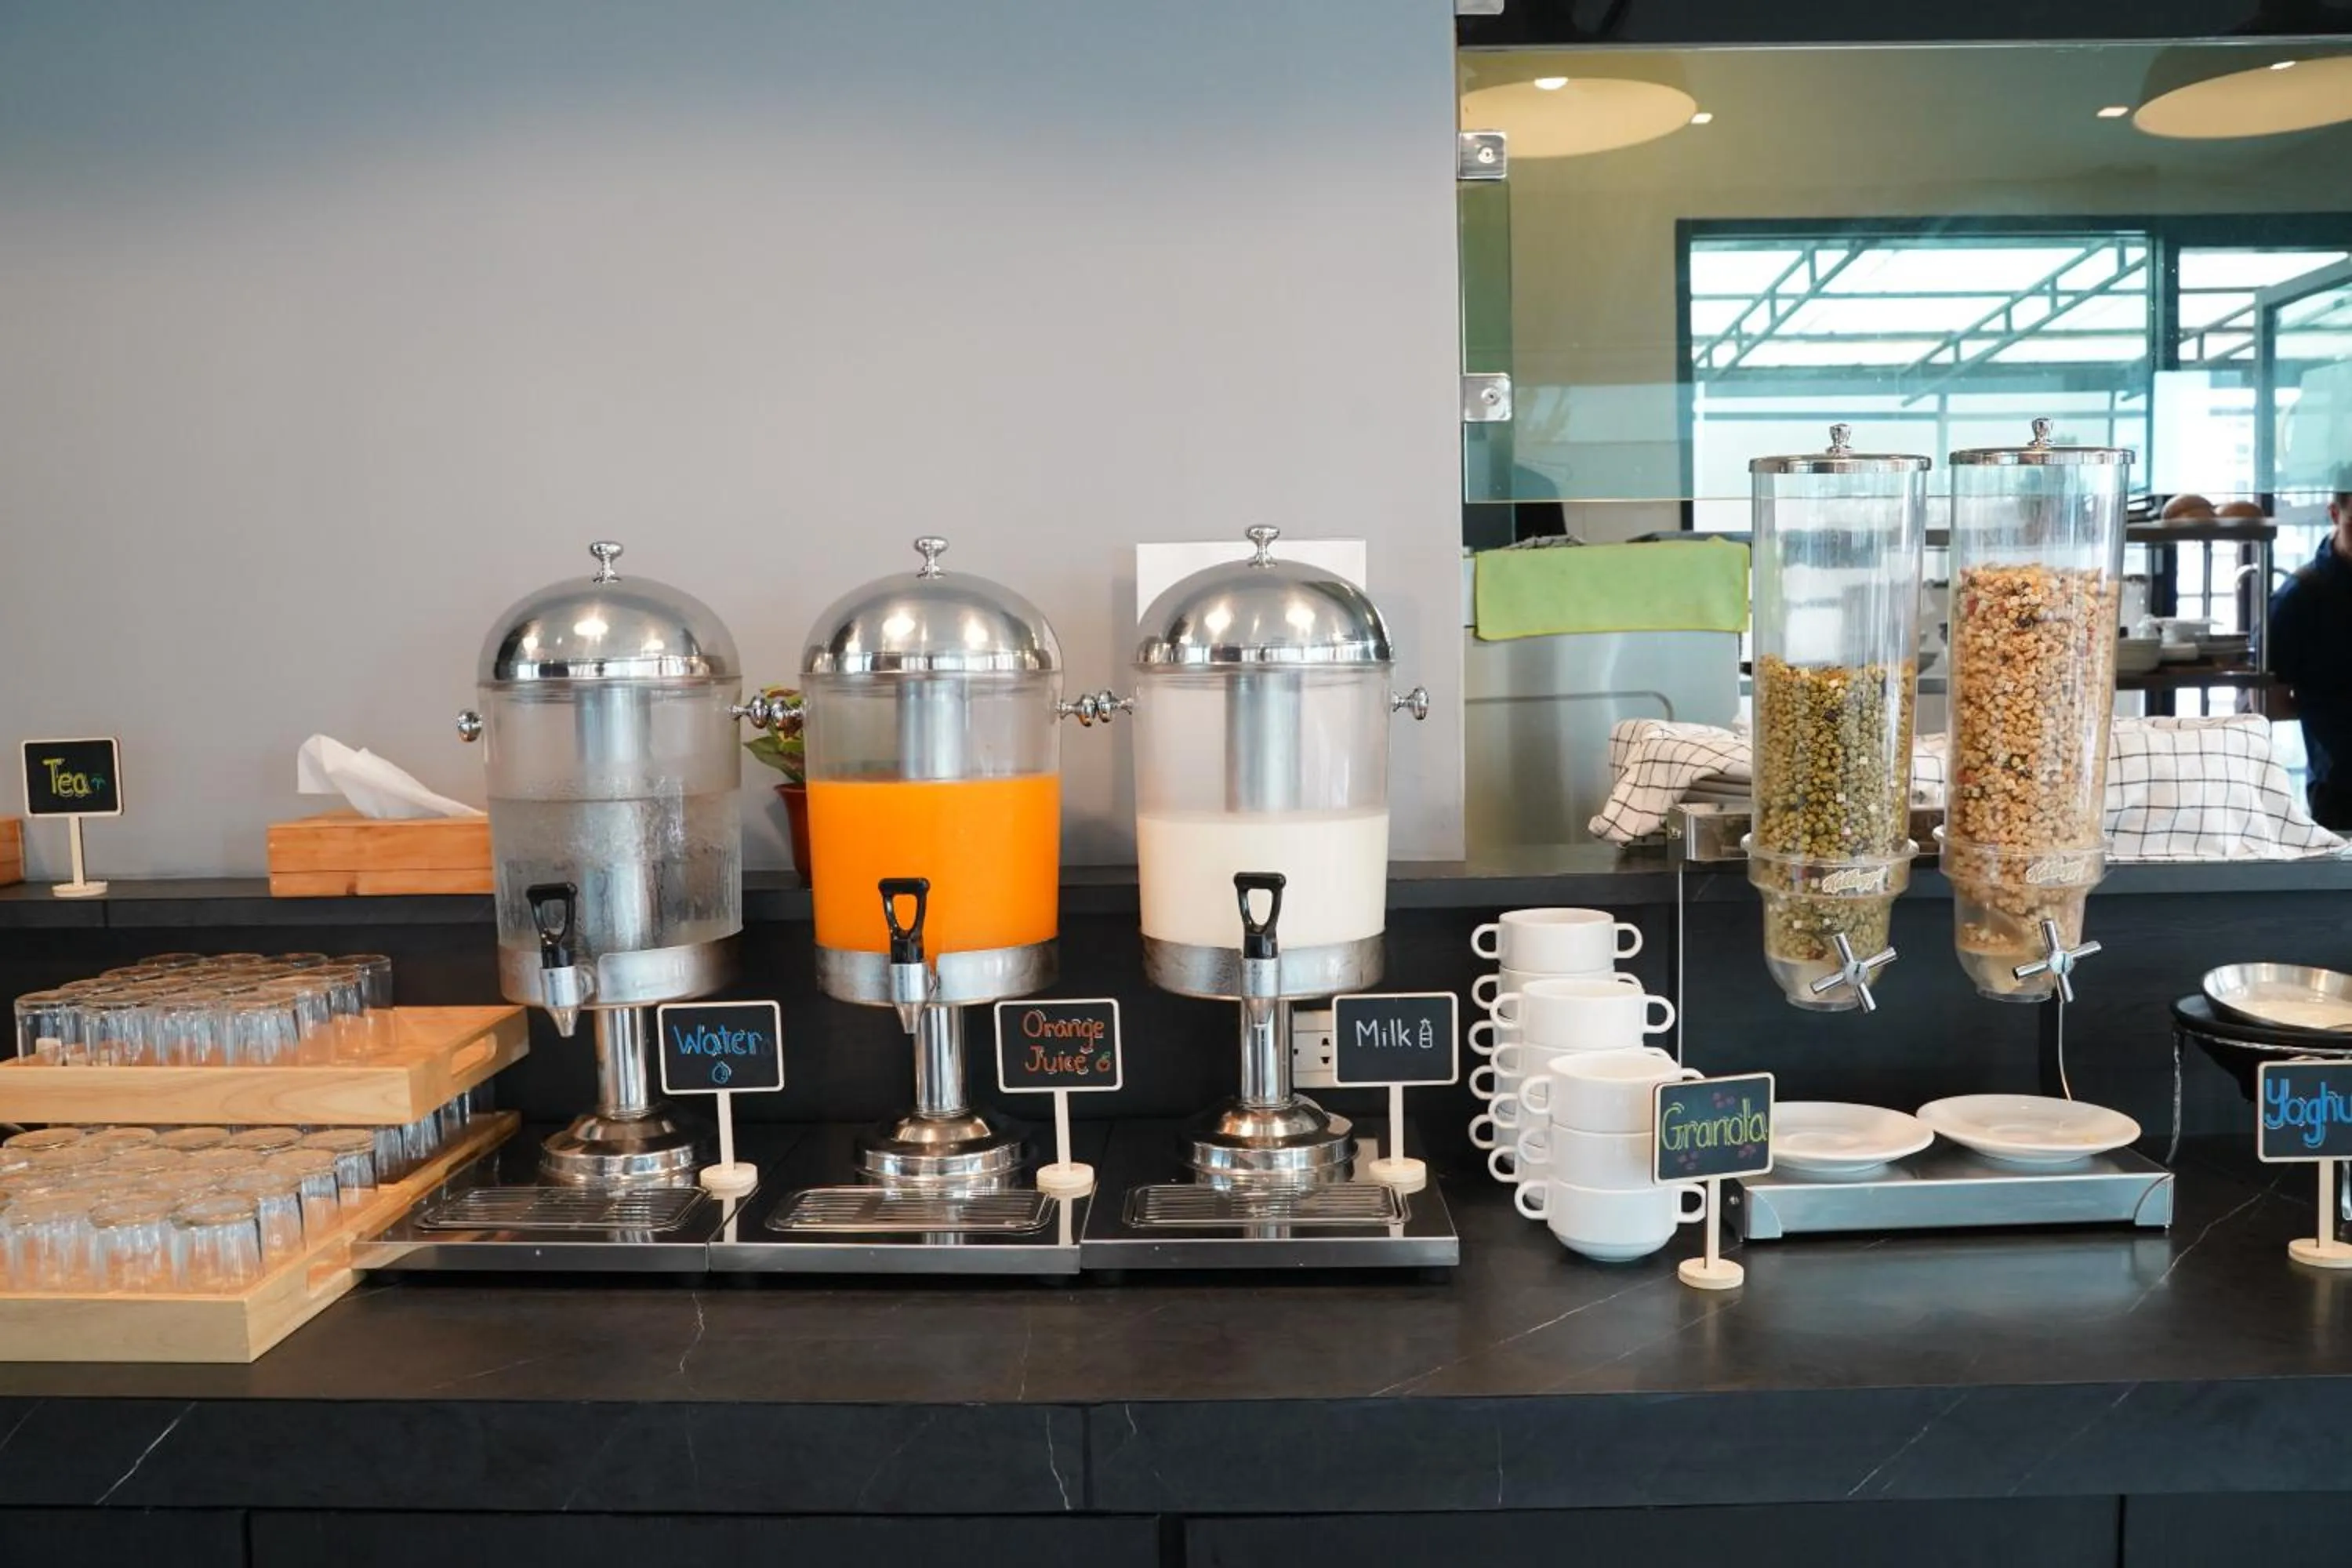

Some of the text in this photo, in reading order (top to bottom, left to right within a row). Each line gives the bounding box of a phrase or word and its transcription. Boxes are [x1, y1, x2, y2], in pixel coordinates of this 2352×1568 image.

[42, 757, 93, 798] Tea
[673, 1024, 763, 1056] Water
[1022, 1009, 1105, 1054] Orange
[1356, 1018, 1412, 1048] Milk
[1025, 1045, 1089, 1075] Juice
[1661, 1098, 1768, 1151] Granola
